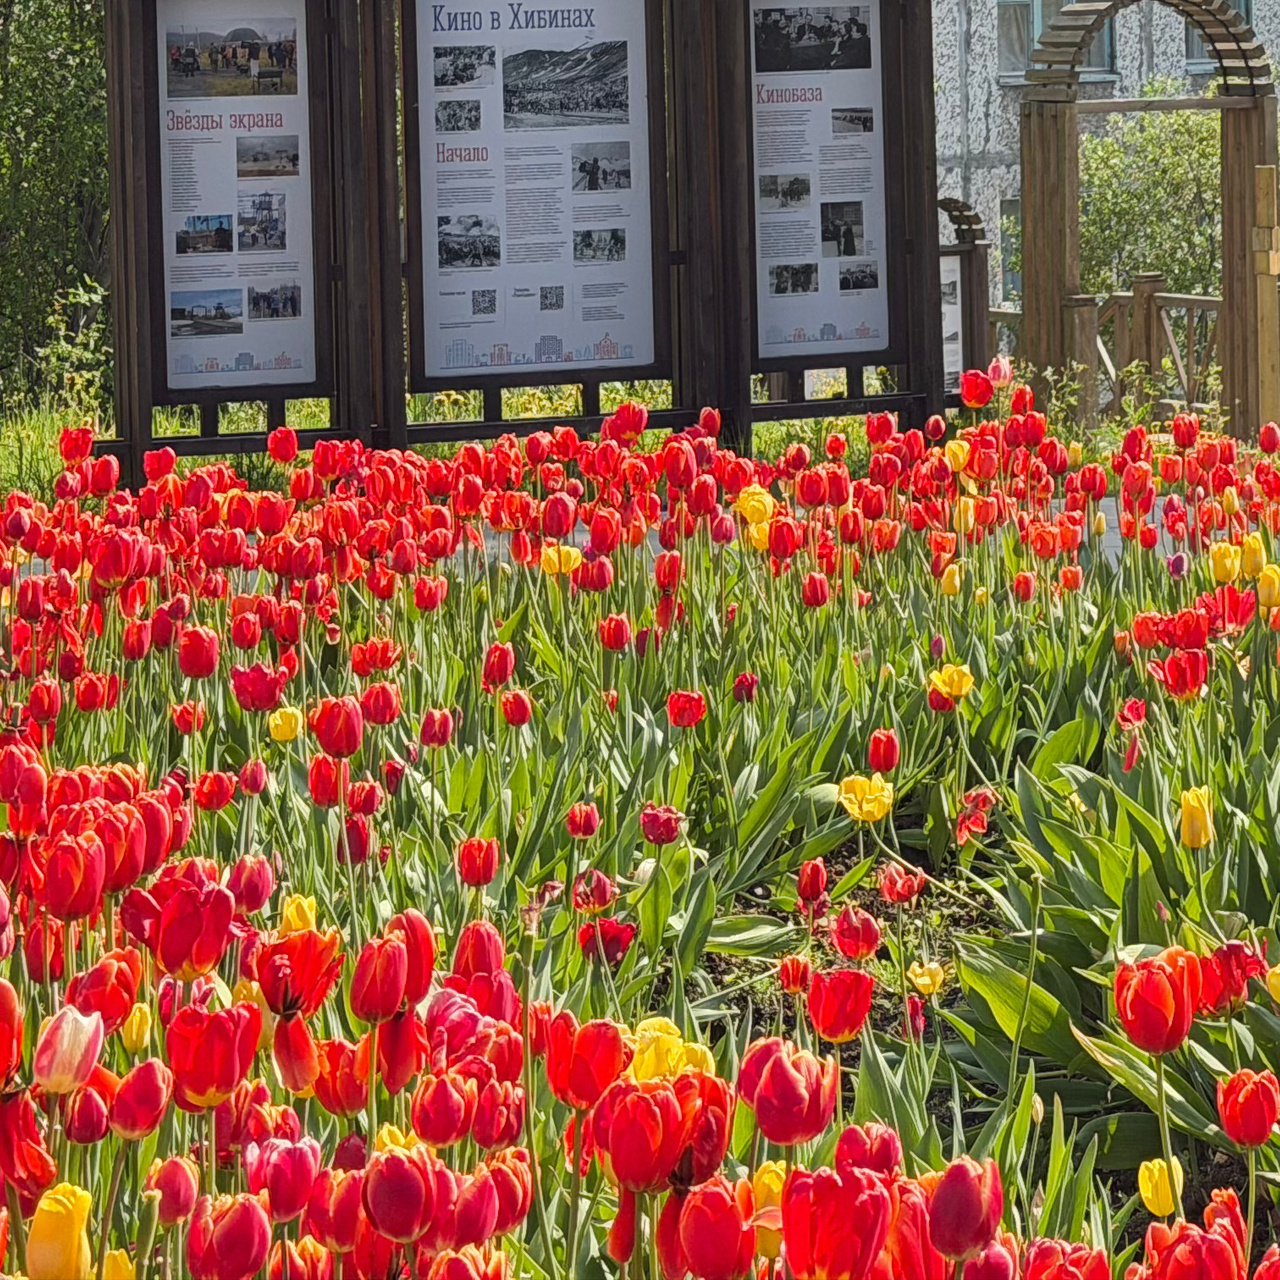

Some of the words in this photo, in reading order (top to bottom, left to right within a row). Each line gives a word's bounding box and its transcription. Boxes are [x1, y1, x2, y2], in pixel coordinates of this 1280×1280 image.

[432, 4, 482, 32] Кино
[490, 11, 501, 30] в
[508, 3, 595, 29] Хибинах
[756, 84, 822, 104] Кинобаза
[166, 109, 223, 131] Звёзды
[229, 112, 283, 131] экрана
[436, 142, 489, 163] Начало
